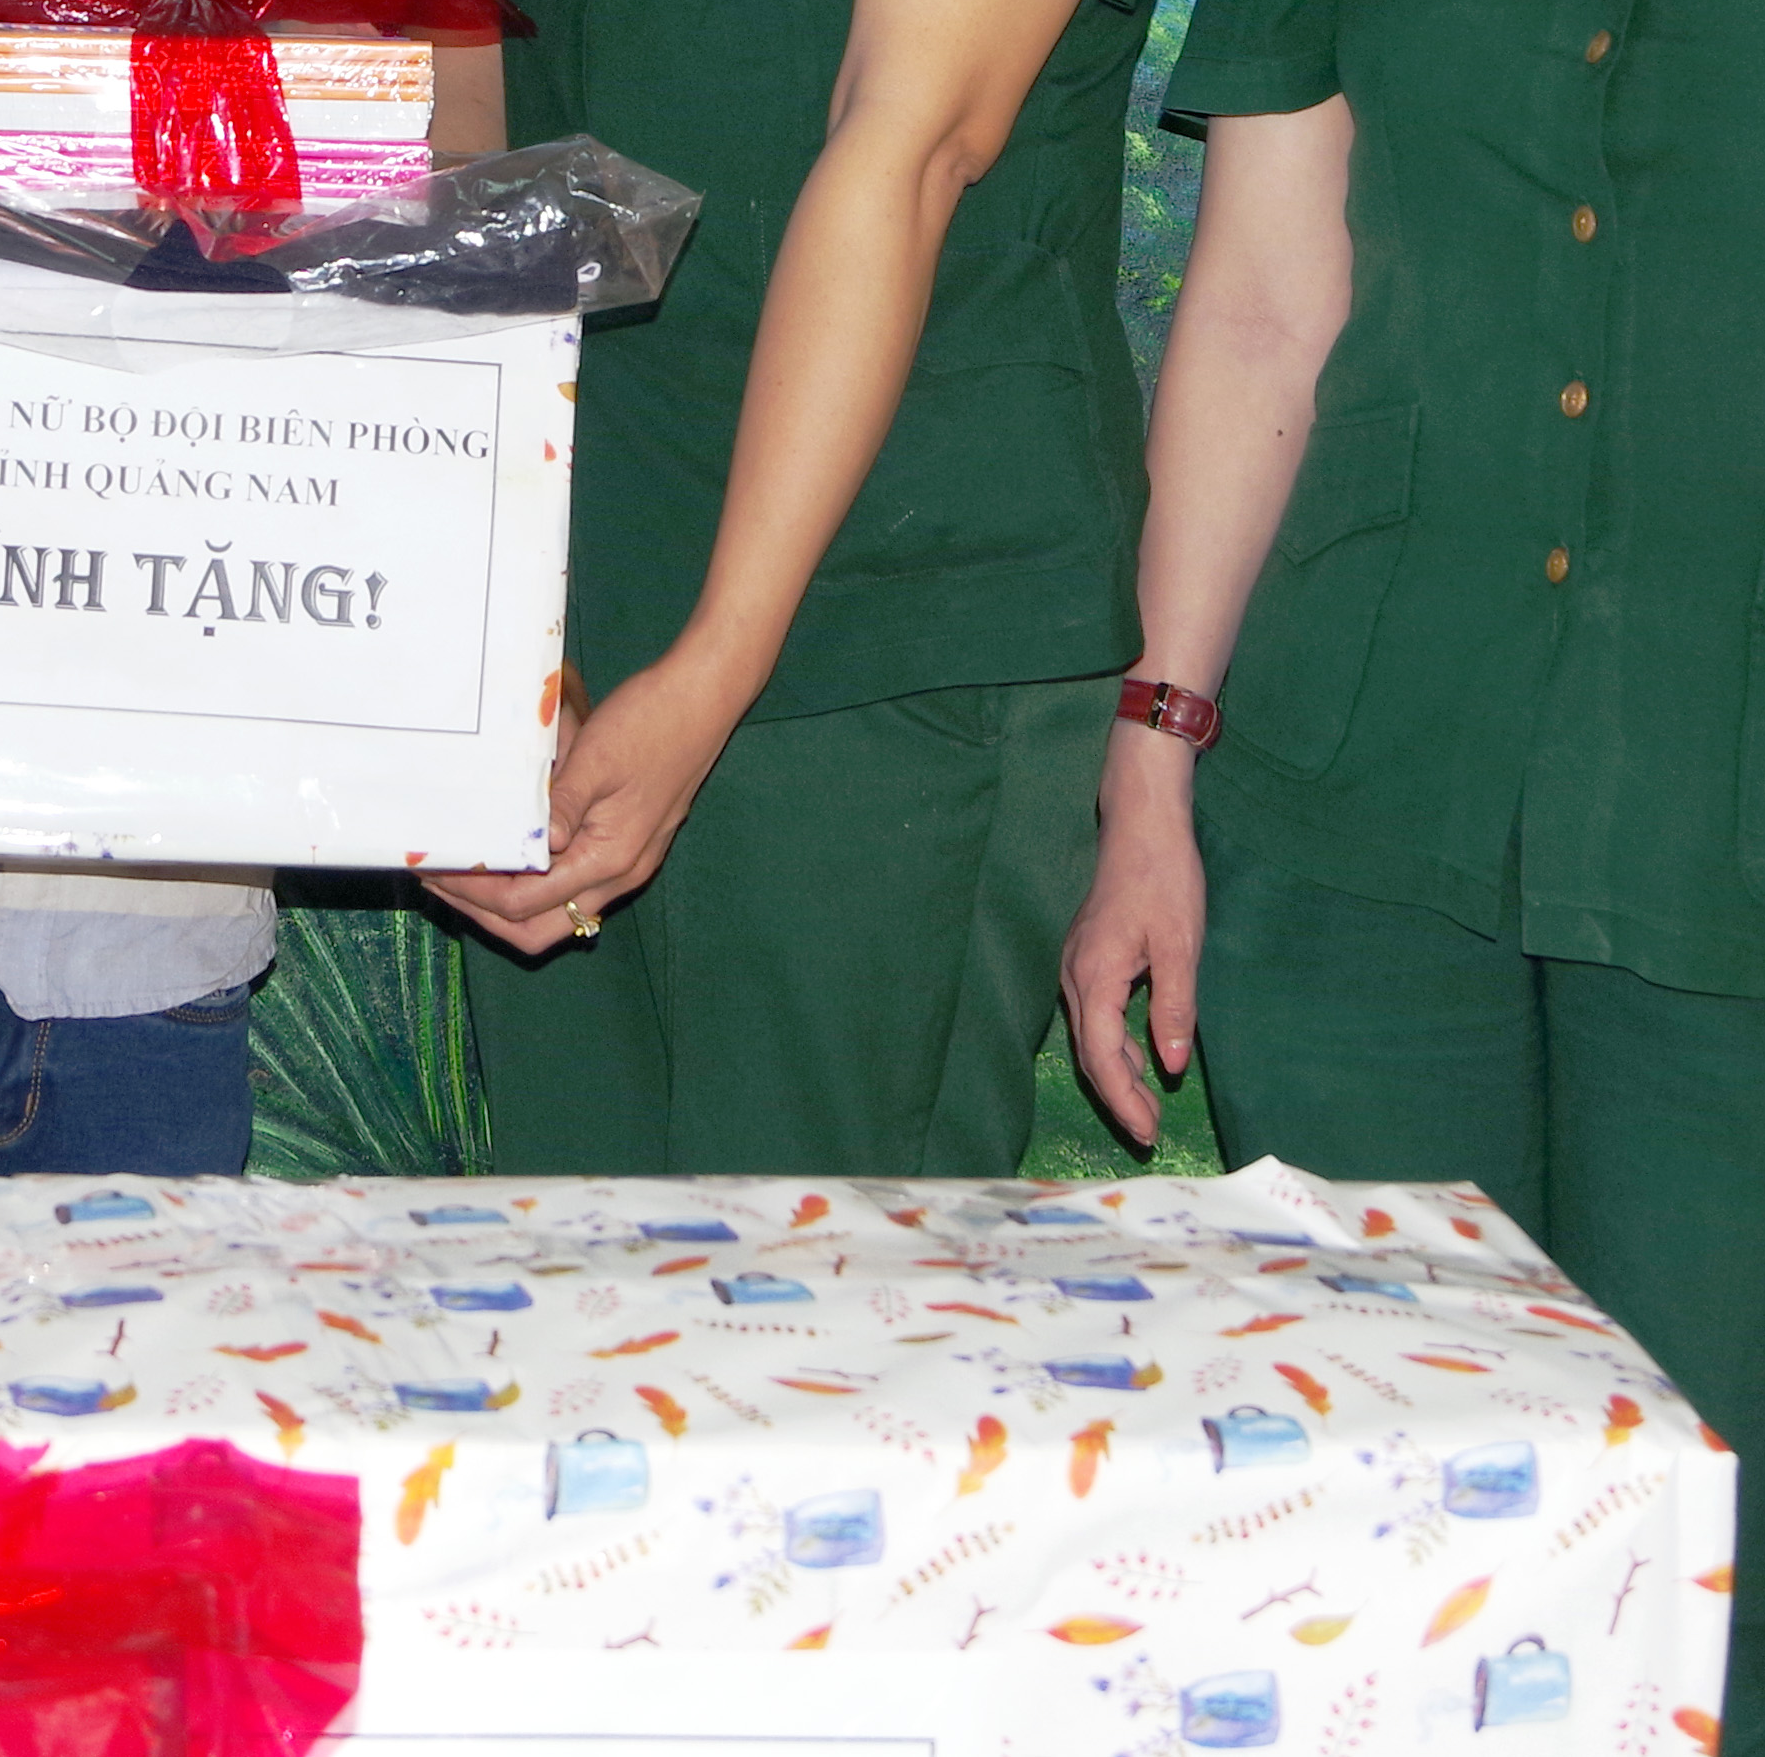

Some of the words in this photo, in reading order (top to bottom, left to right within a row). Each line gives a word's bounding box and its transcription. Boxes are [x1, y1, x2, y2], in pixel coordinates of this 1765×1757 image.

[9, 395, 73, 431] NỮ
[83, 402, 138, 444] BỘ
[151, 406, 223, 447] ĐỘI
[238, 409, 333, 448] BIÊN
[347, 417, 489, 459] PHÒNG
[85, 458, 232, 499] QUẢNG
[245, 473, 338, 507] NAM
[132, 540, 389, 637] TẶNG!
